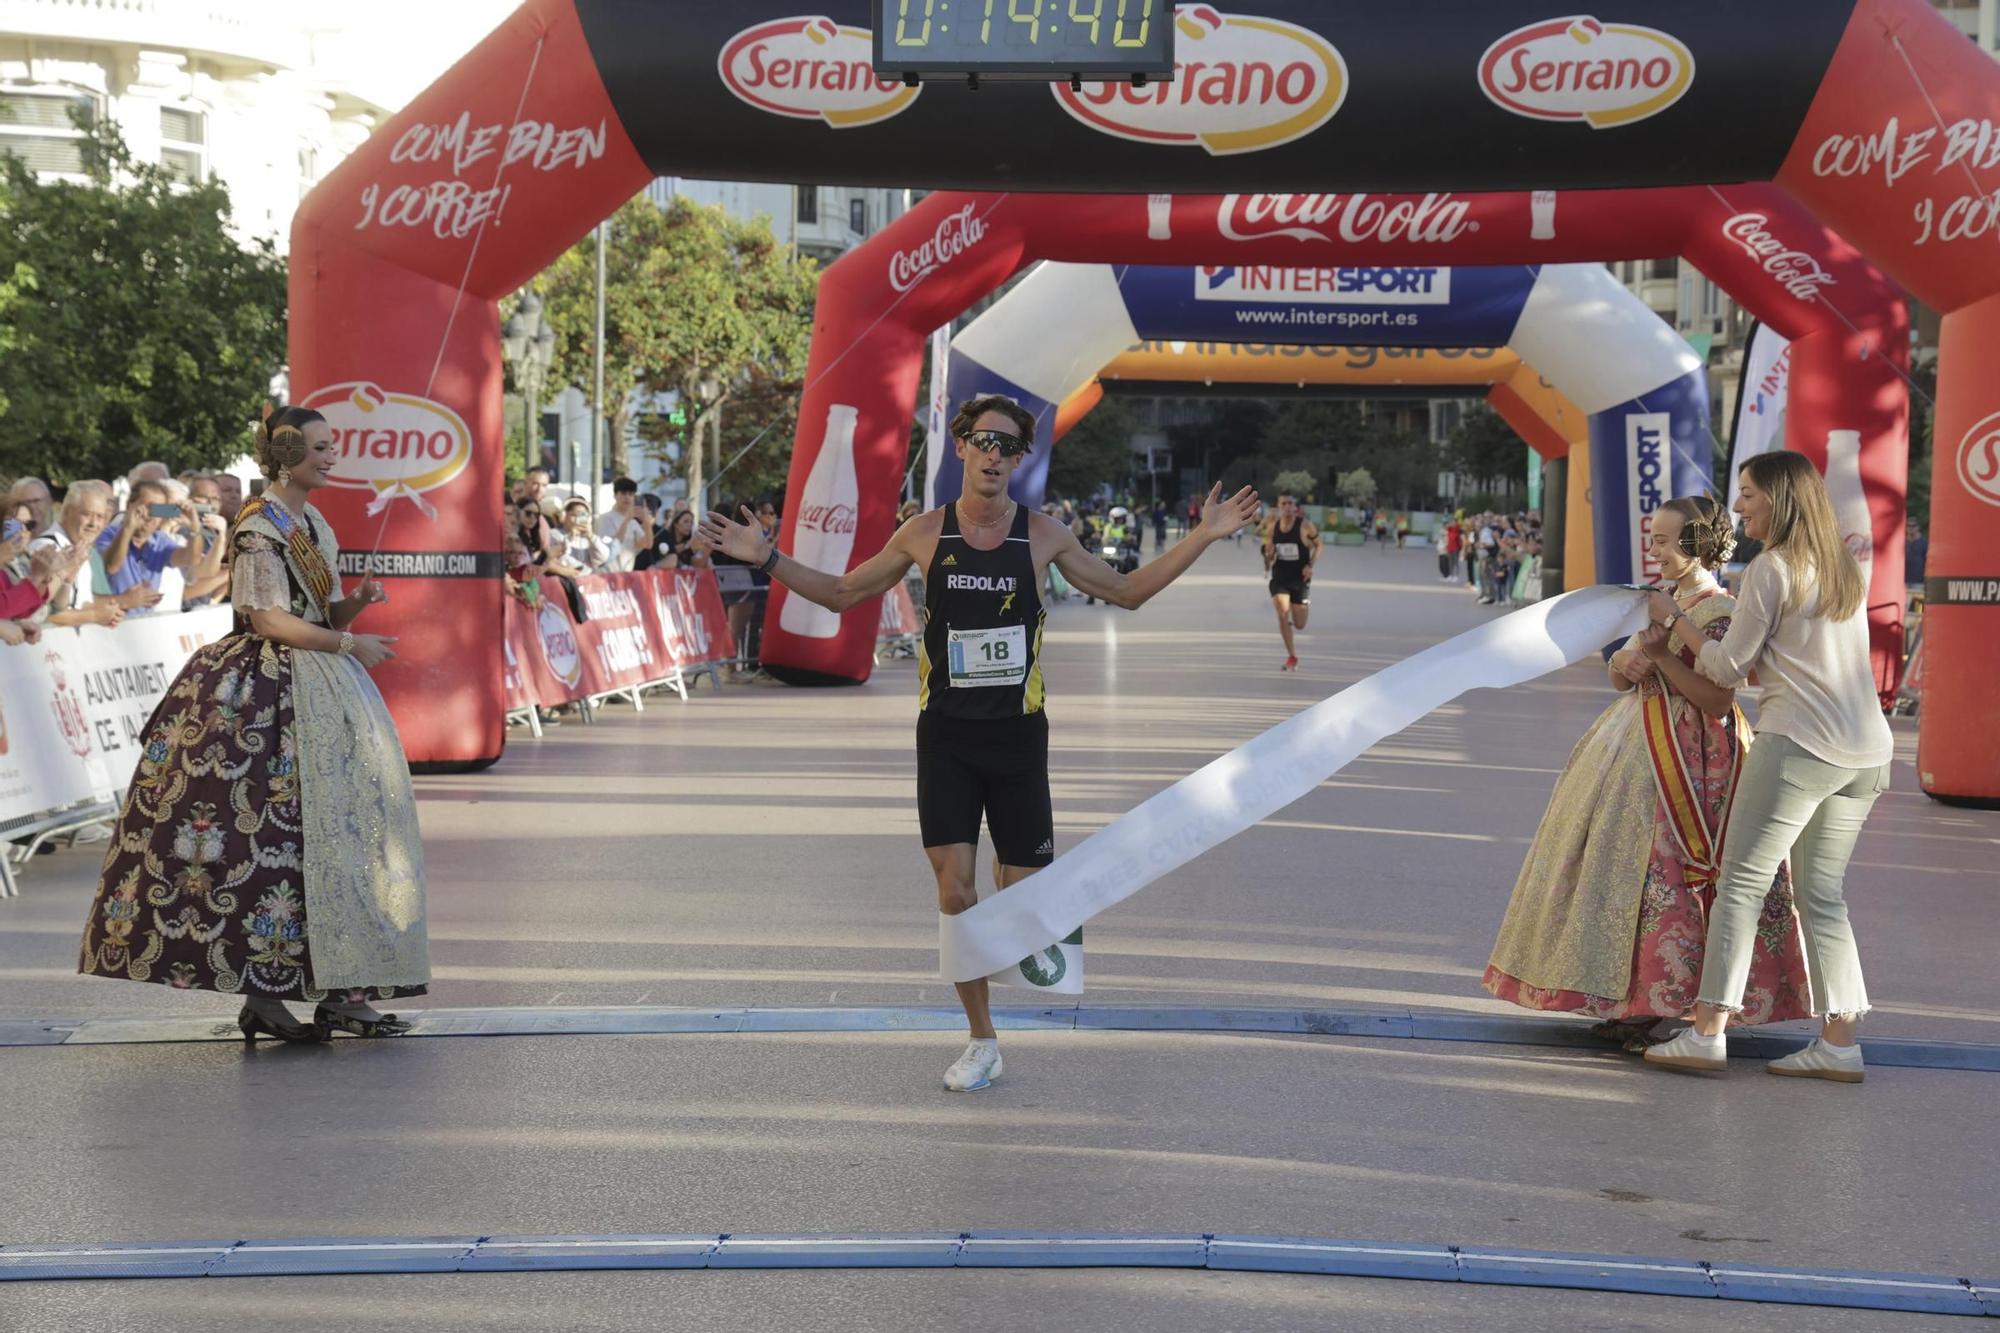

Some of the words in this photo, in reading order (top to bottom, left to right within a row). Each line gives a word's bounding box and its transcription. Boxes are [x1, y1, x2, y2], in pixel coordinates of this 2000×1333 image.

[750, 45, 900, 92] Serran
[1502, 48, 1672, 94] Serrano
[390, 111, 502, 175] COME
[502, 117, 605, 170] BIEN
[1813, 117, 1937, 187] COME
[379, 181, 511, 238] CORRE!
[1218, 193, 1470, 242] CocaCola
[1240, 265, 1435, 293] INTERSPORT
[1235, 308, 1419, 327] www.intersport.es
[331, 428, 453, 461] rrano
[339, 553, 476, 575] ATEASERRANO.COM
[947, 574, 1013, 591] REDOLAT
[980, 641, 1009, 661] 18
[84, 662, 169, 706] AJUNTAMENT
